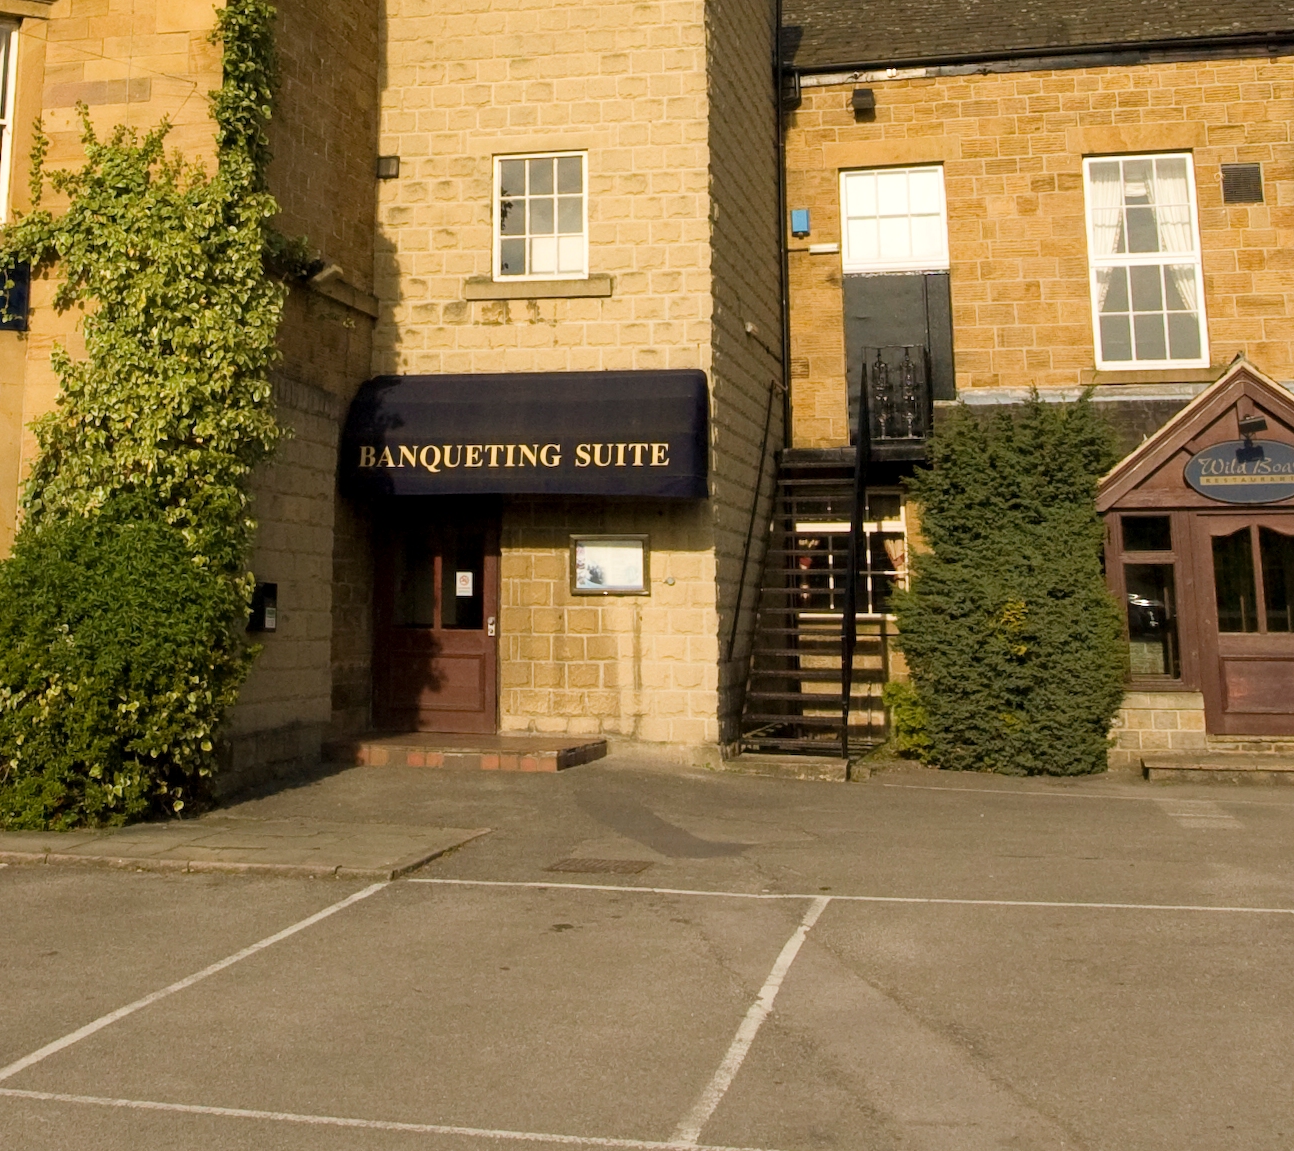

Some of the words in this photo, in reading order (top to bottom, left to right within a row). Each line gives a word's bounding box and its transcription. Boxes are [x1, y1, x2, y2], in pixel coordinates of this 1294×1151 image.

[358, 443, 562, 473] BANQUETING
[574, 443, 670, 467] SUITE
[1198, 457, 1247, 475] Wild
